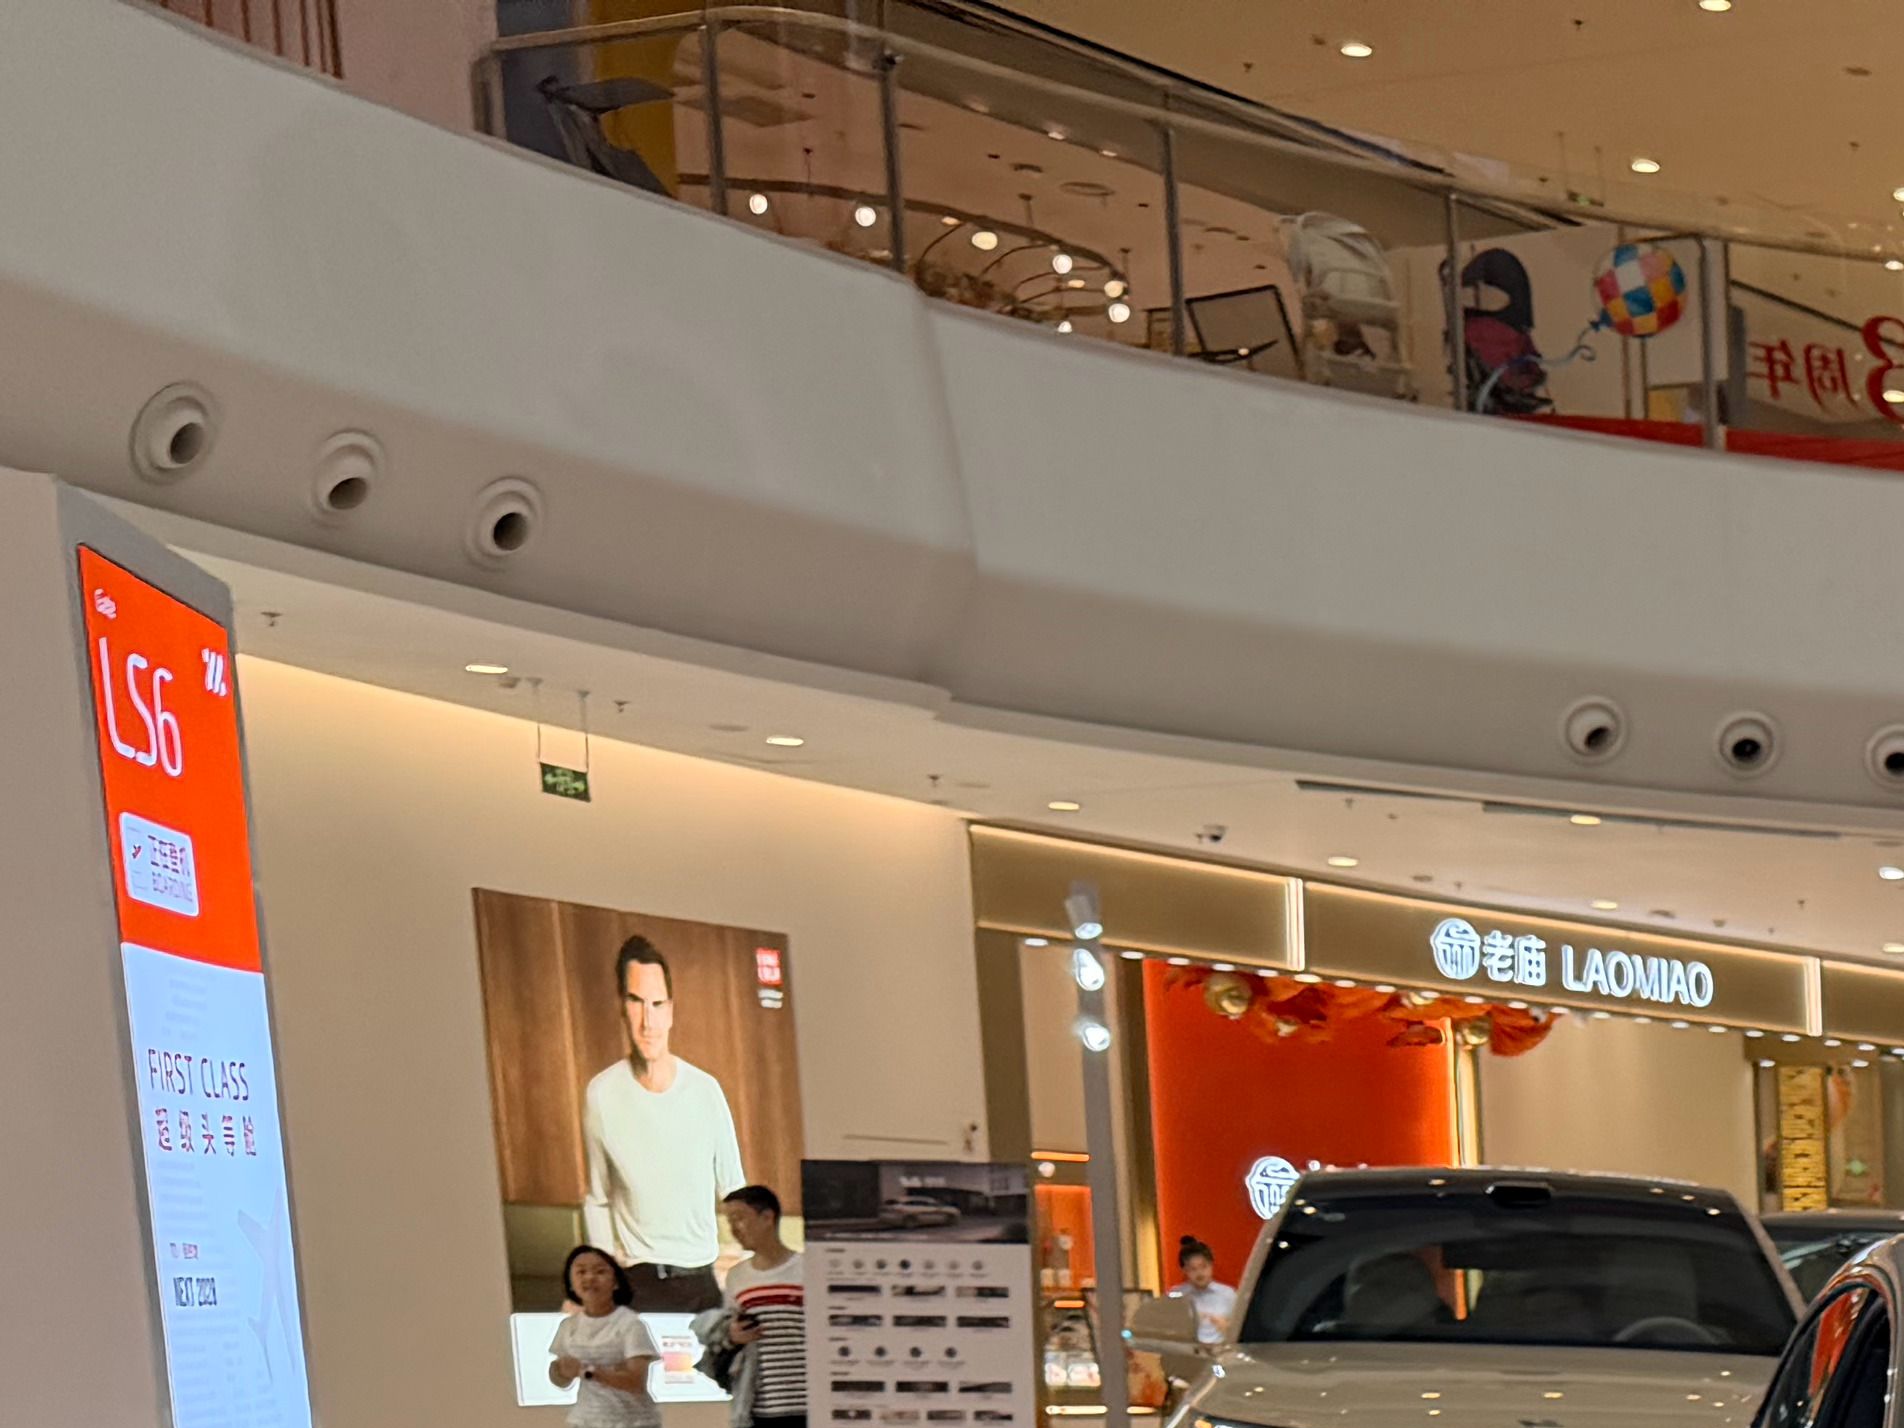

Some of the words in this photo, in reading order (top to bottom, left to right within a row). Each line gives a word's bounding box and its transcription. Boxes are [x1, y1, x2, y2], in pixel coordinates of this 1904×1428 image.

[98, 636, 183, 777] LS6
[1482, 929, 1548, 988] 老庙
[1562, 943, 1716, 1009] LAOMIAO
[148, 1048, 195, 1096] FIRST
[200, 1057, 250, 1102] CLASS
